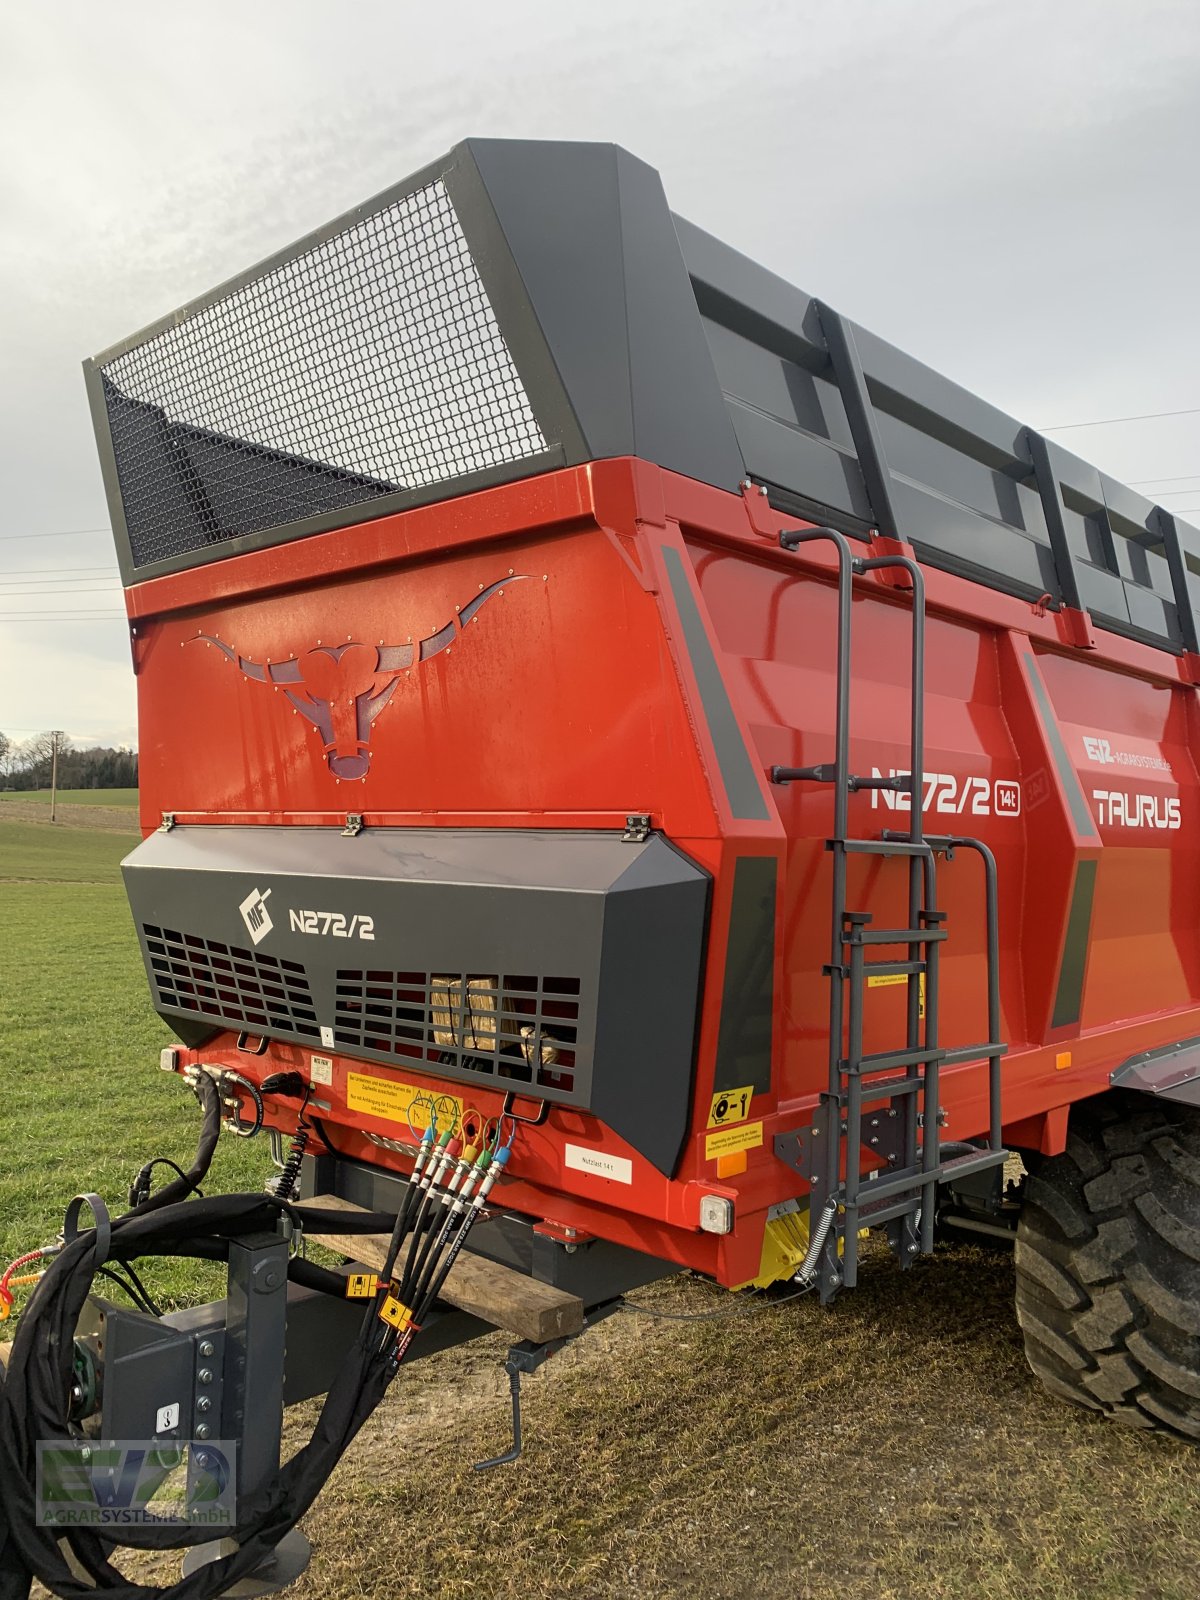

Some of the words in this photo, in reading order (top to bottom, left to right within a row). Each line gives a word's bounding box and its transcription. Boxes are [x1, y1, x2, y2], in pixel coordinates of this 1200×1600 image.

[1000, 789, 1016, 807] 14t
[1093, 789, 1181, 829] TAURUS
[289, 909, 375, 940] N272/2
[582, 1157, 602, 1168] Nutzlast
